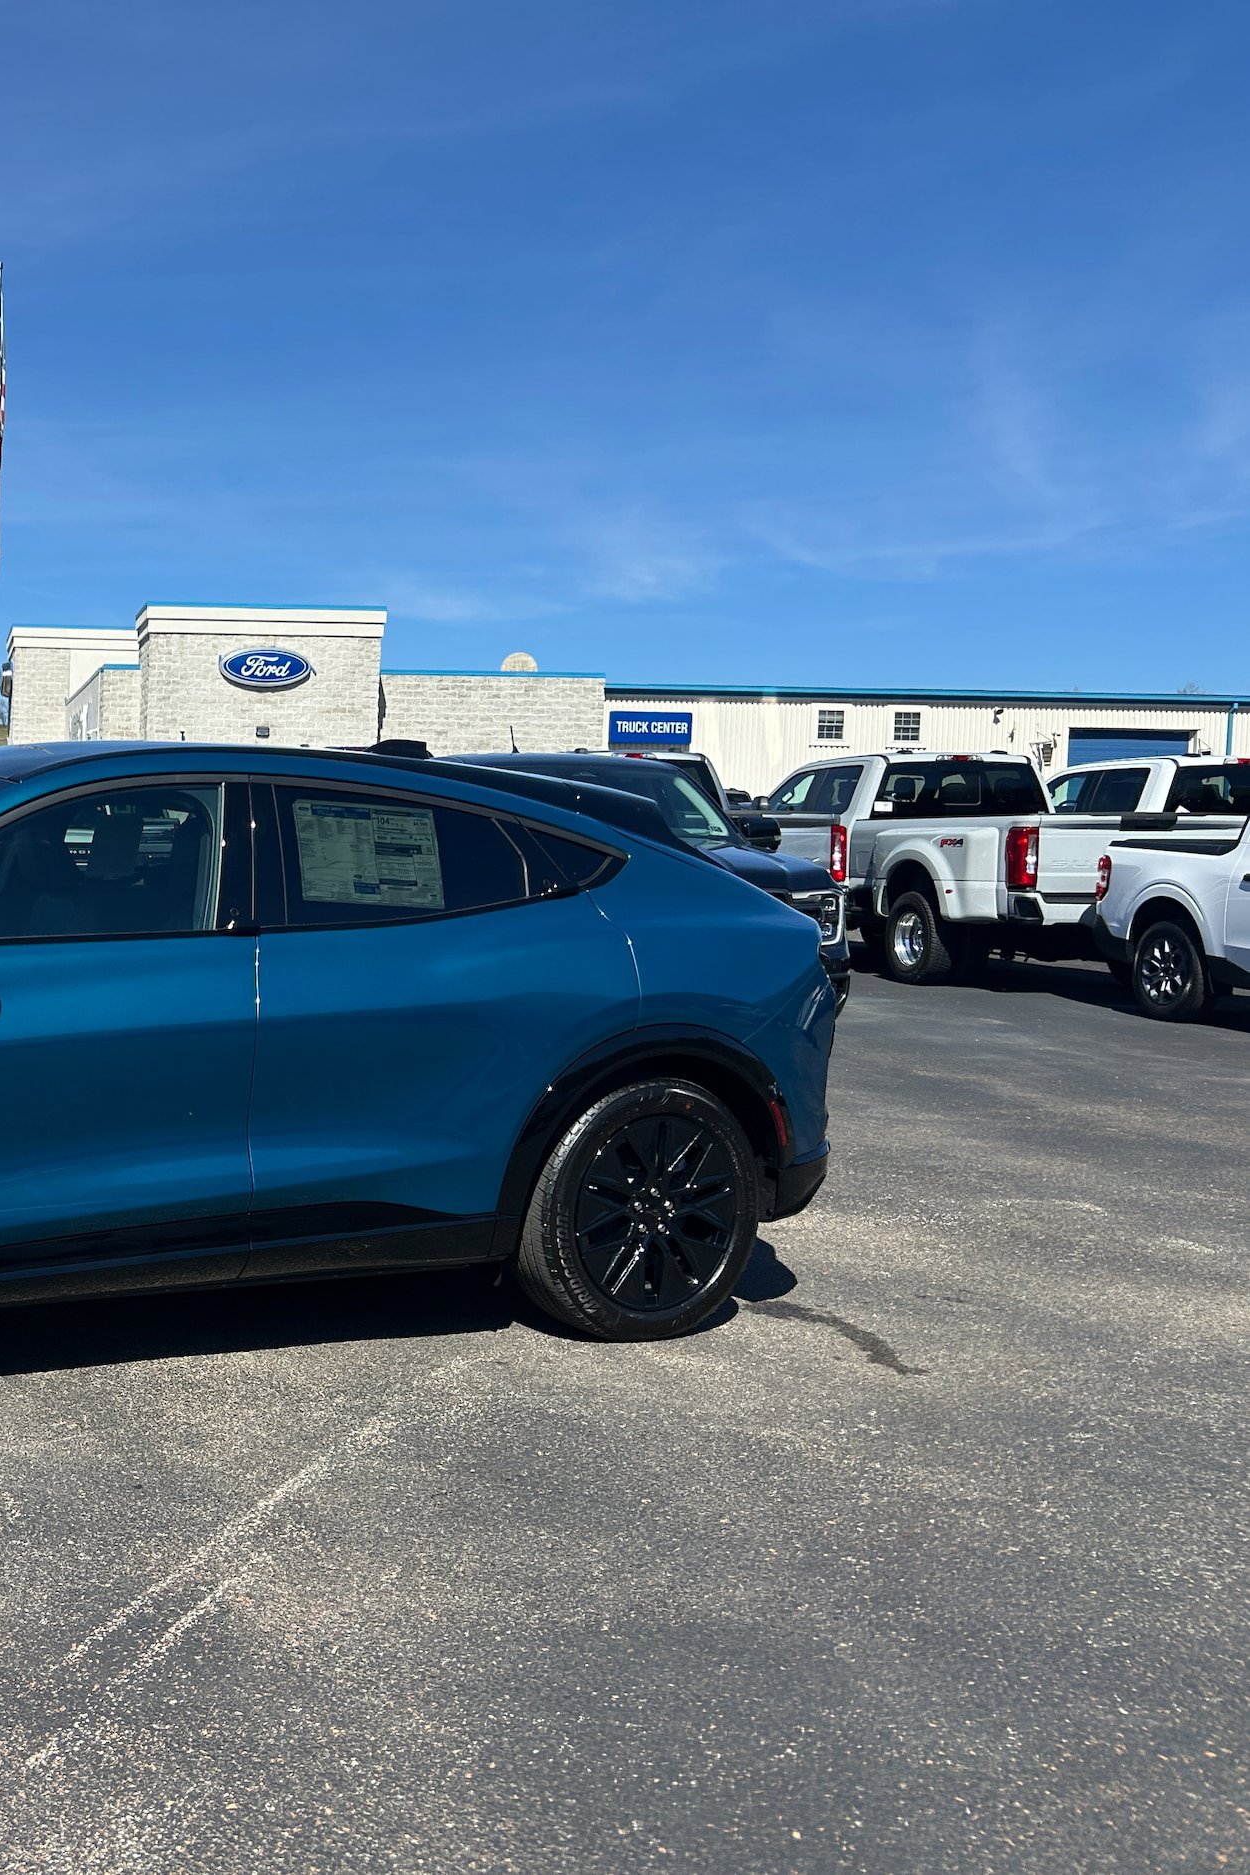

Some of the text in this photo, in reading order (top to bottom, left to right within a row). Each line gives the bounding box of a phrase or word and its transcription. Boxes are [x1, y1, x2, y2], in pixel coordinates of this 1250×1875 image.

[240, 655, 291, 677] Ford
[616, 720, 688, 735] TRUCK CENTER
[376, 816, 390, 826] 104
[940, 838, 963, 847] FX4
